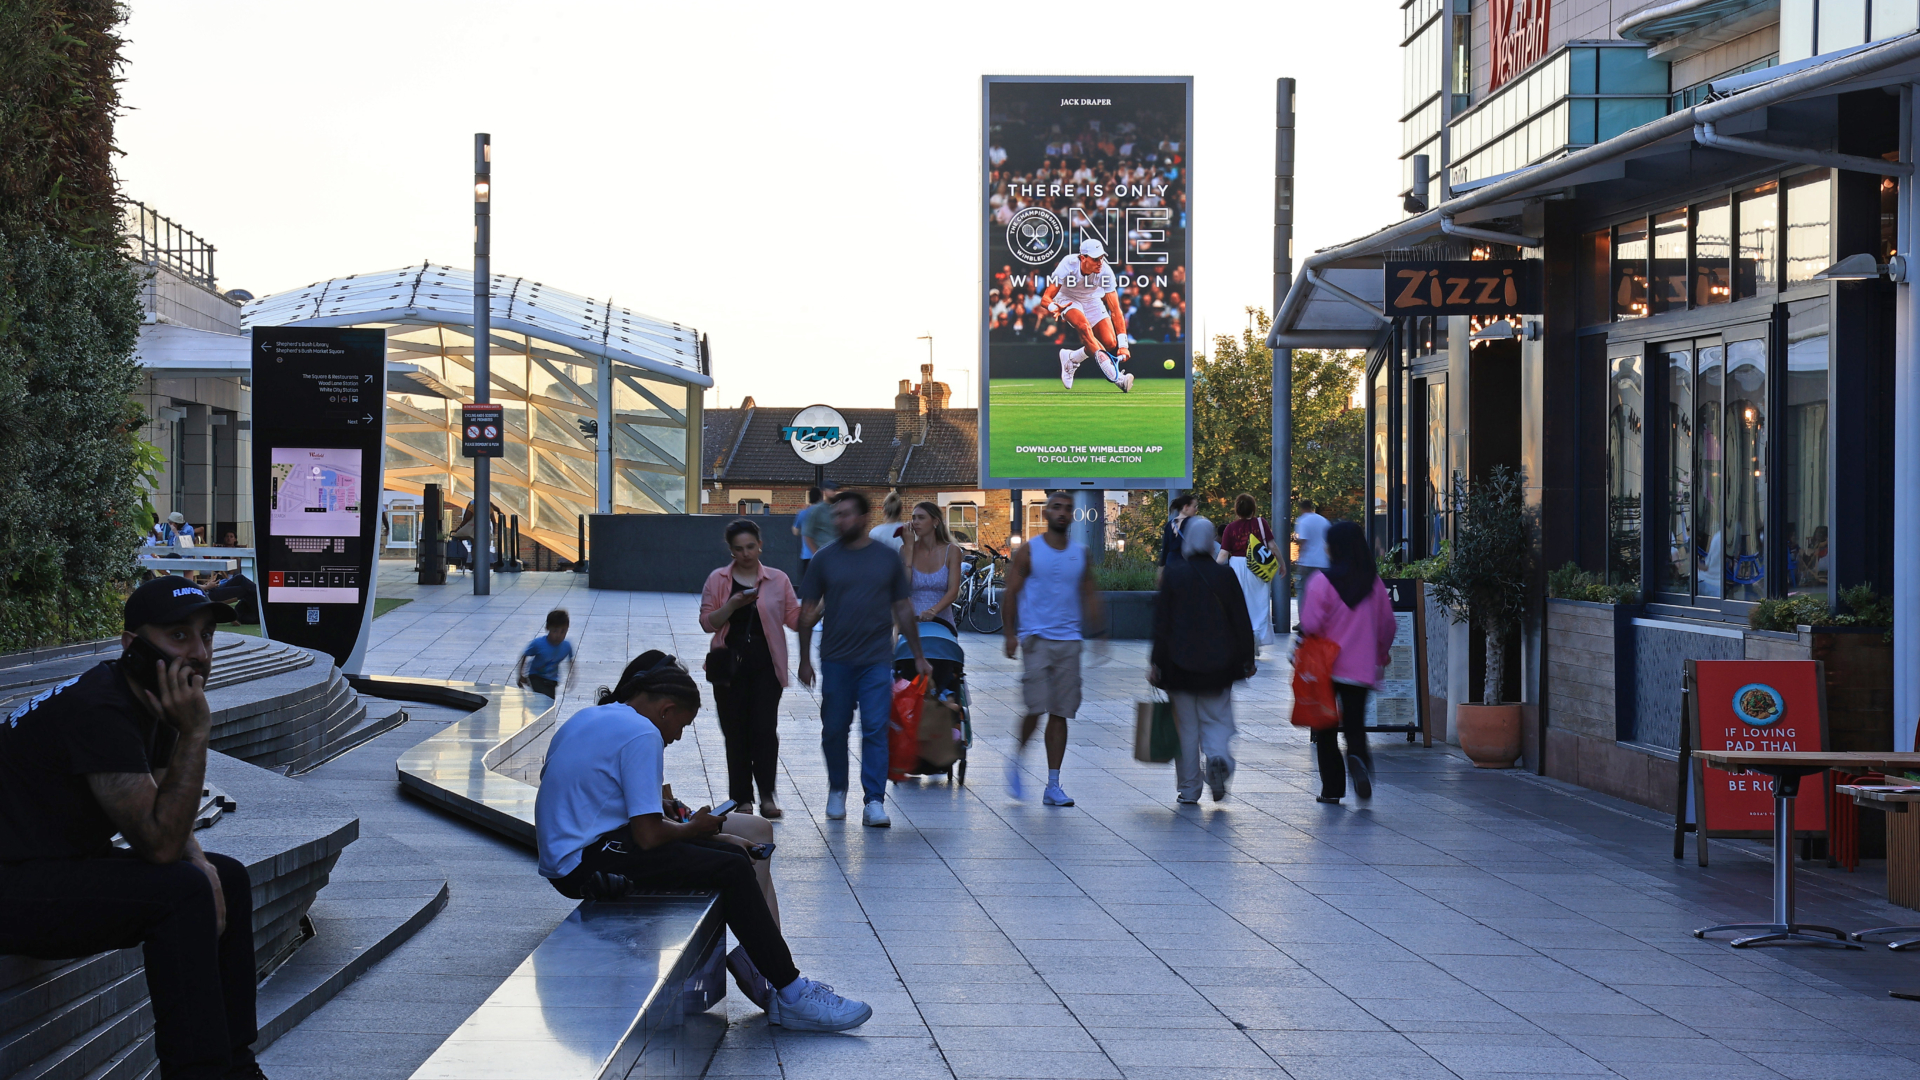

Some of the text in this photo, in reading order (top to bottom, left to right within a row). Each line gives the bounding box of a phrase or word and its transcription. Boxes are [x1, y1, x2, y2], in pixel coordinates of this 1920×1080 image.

[1488, 0, 1550, 93] Westfield
[1060, 98, 1112, 107] JACK DRAPER
[1007, 184, 1169, 197] THERE IS ONLY
[1009, 210, 1061, 235] THE CHAMPIONSHIPS
[1016, 249, 1055, 262] WIMBLEDON
[1009, 275, 1168, 288] WIMBLEDON
[1393, 268, 1518, 308] Zizzi
[782, 426, 840, 441] TOCA
[800, 422, 863, 452] Social
[1015, 445, 1163, 453] DOWNLOAD THE WIMBLEDON APP
[1036, 455, 1142, 463] TO FOLLOW THE ACTION
[1725, 727, 1796, 738] IF LOVING
[1725, 740, 1797, 752] PAD THAI
[1728, 780, 1747, 791] BE
